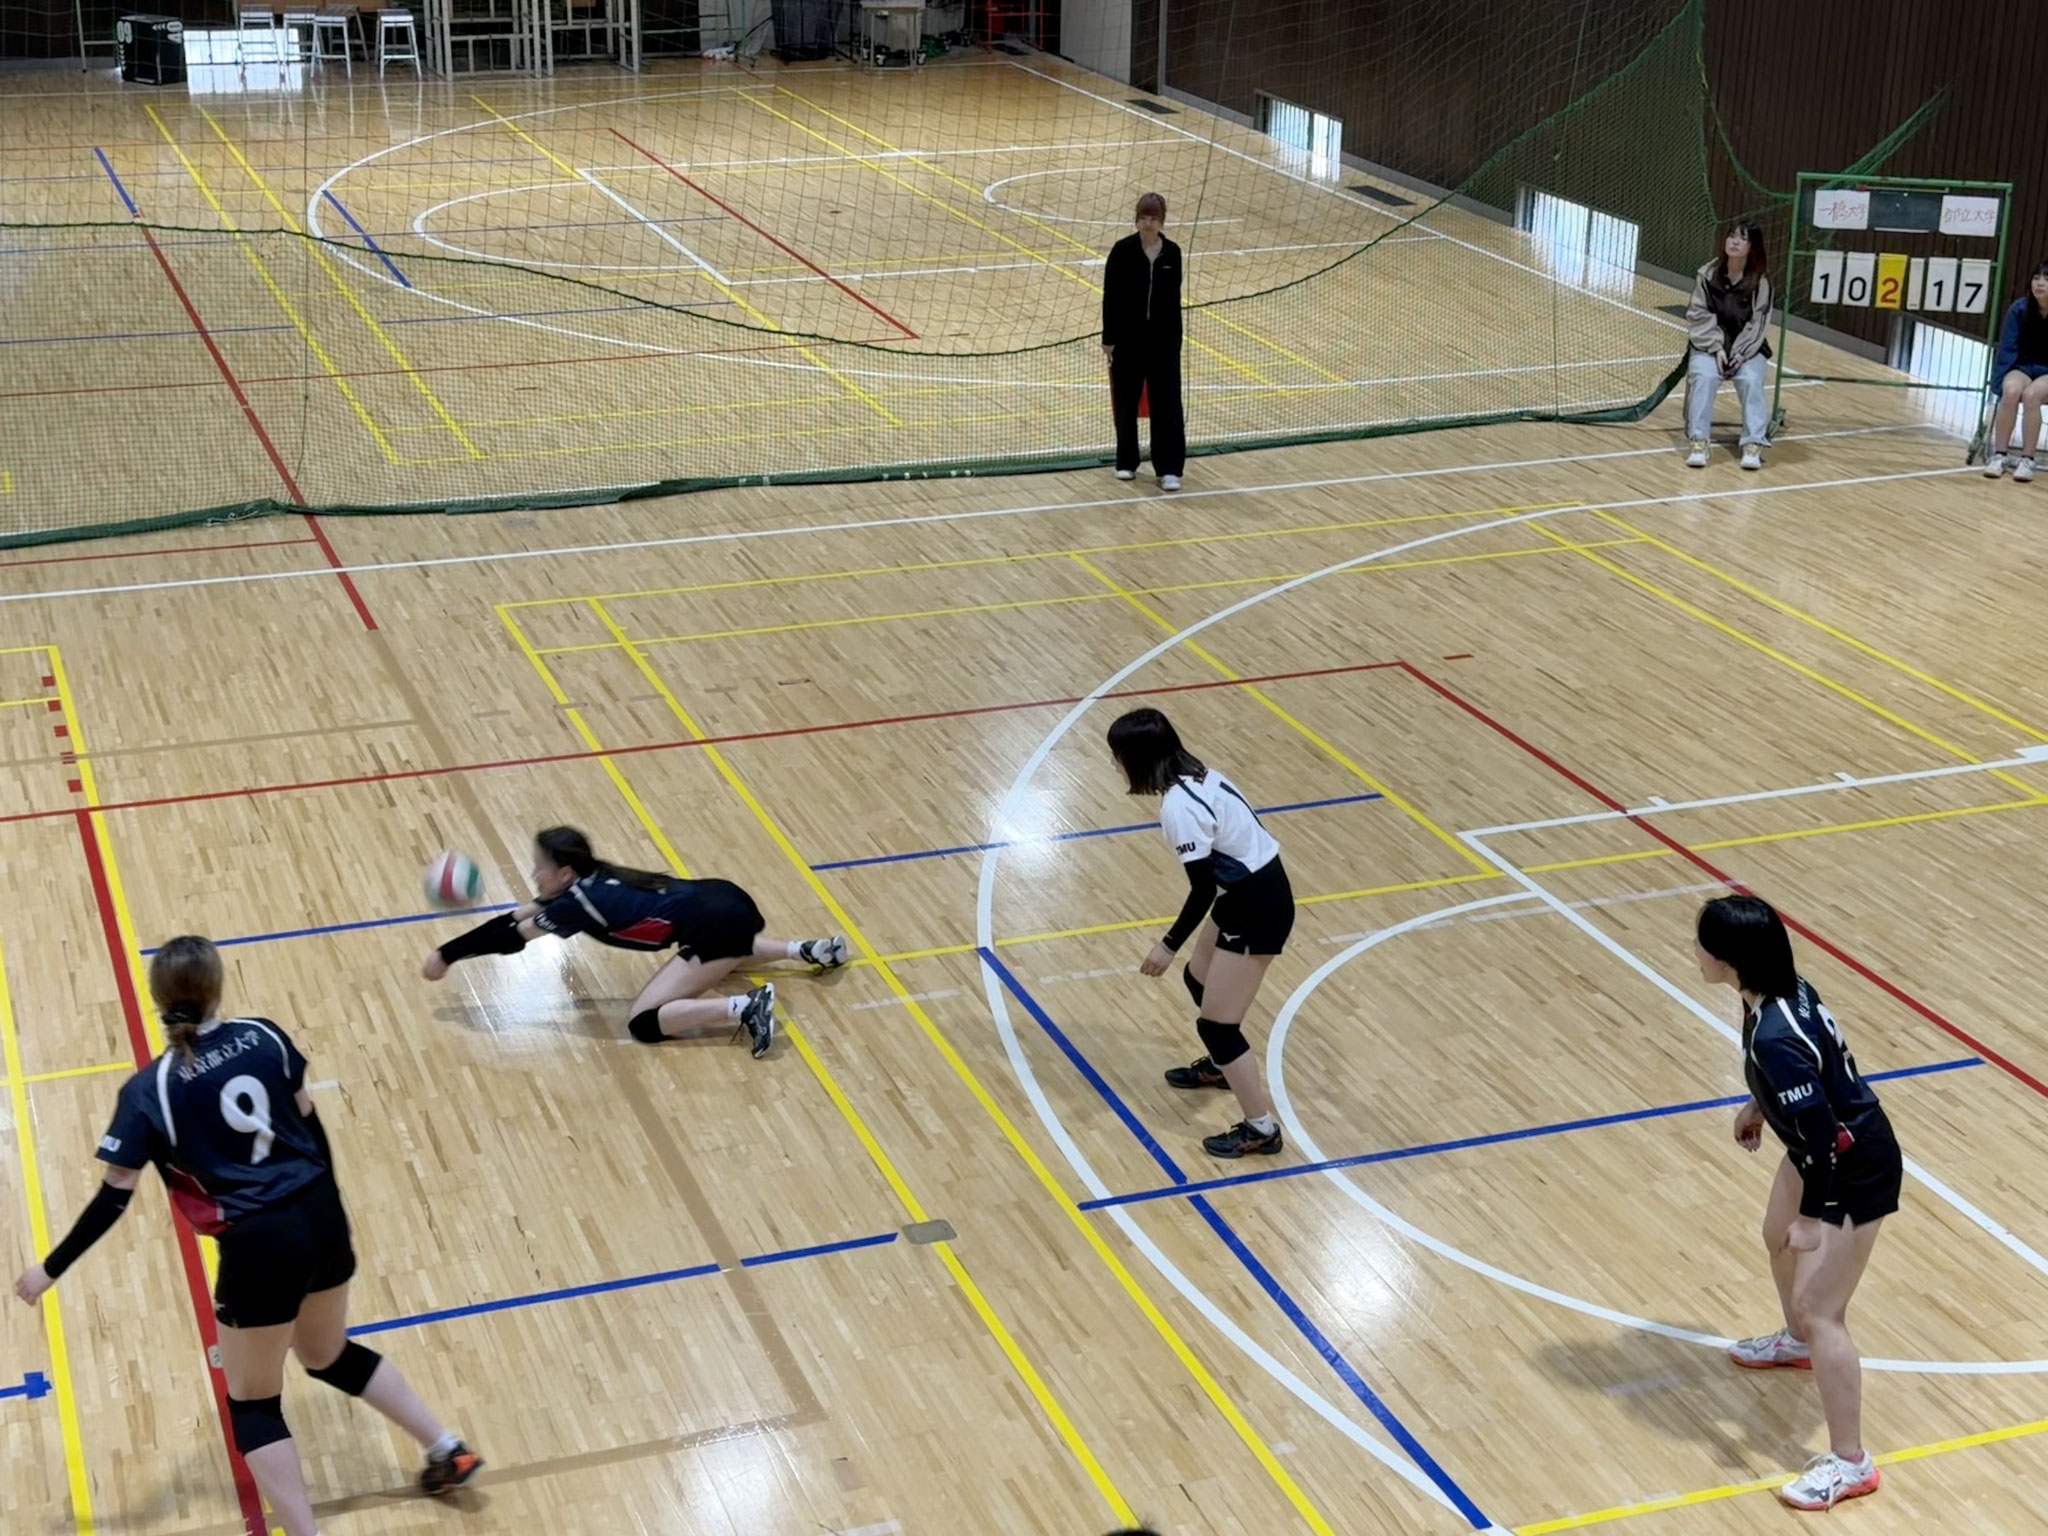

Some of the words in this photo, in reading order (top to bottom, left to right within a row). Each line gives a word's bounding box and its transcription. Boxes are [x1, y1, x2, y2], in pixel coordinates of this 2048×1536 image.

[1881, 277, 1899, 304] 2
[1777, 1082, 1814, 1106] TMU
[220, 1074, 275, 1165] 9
